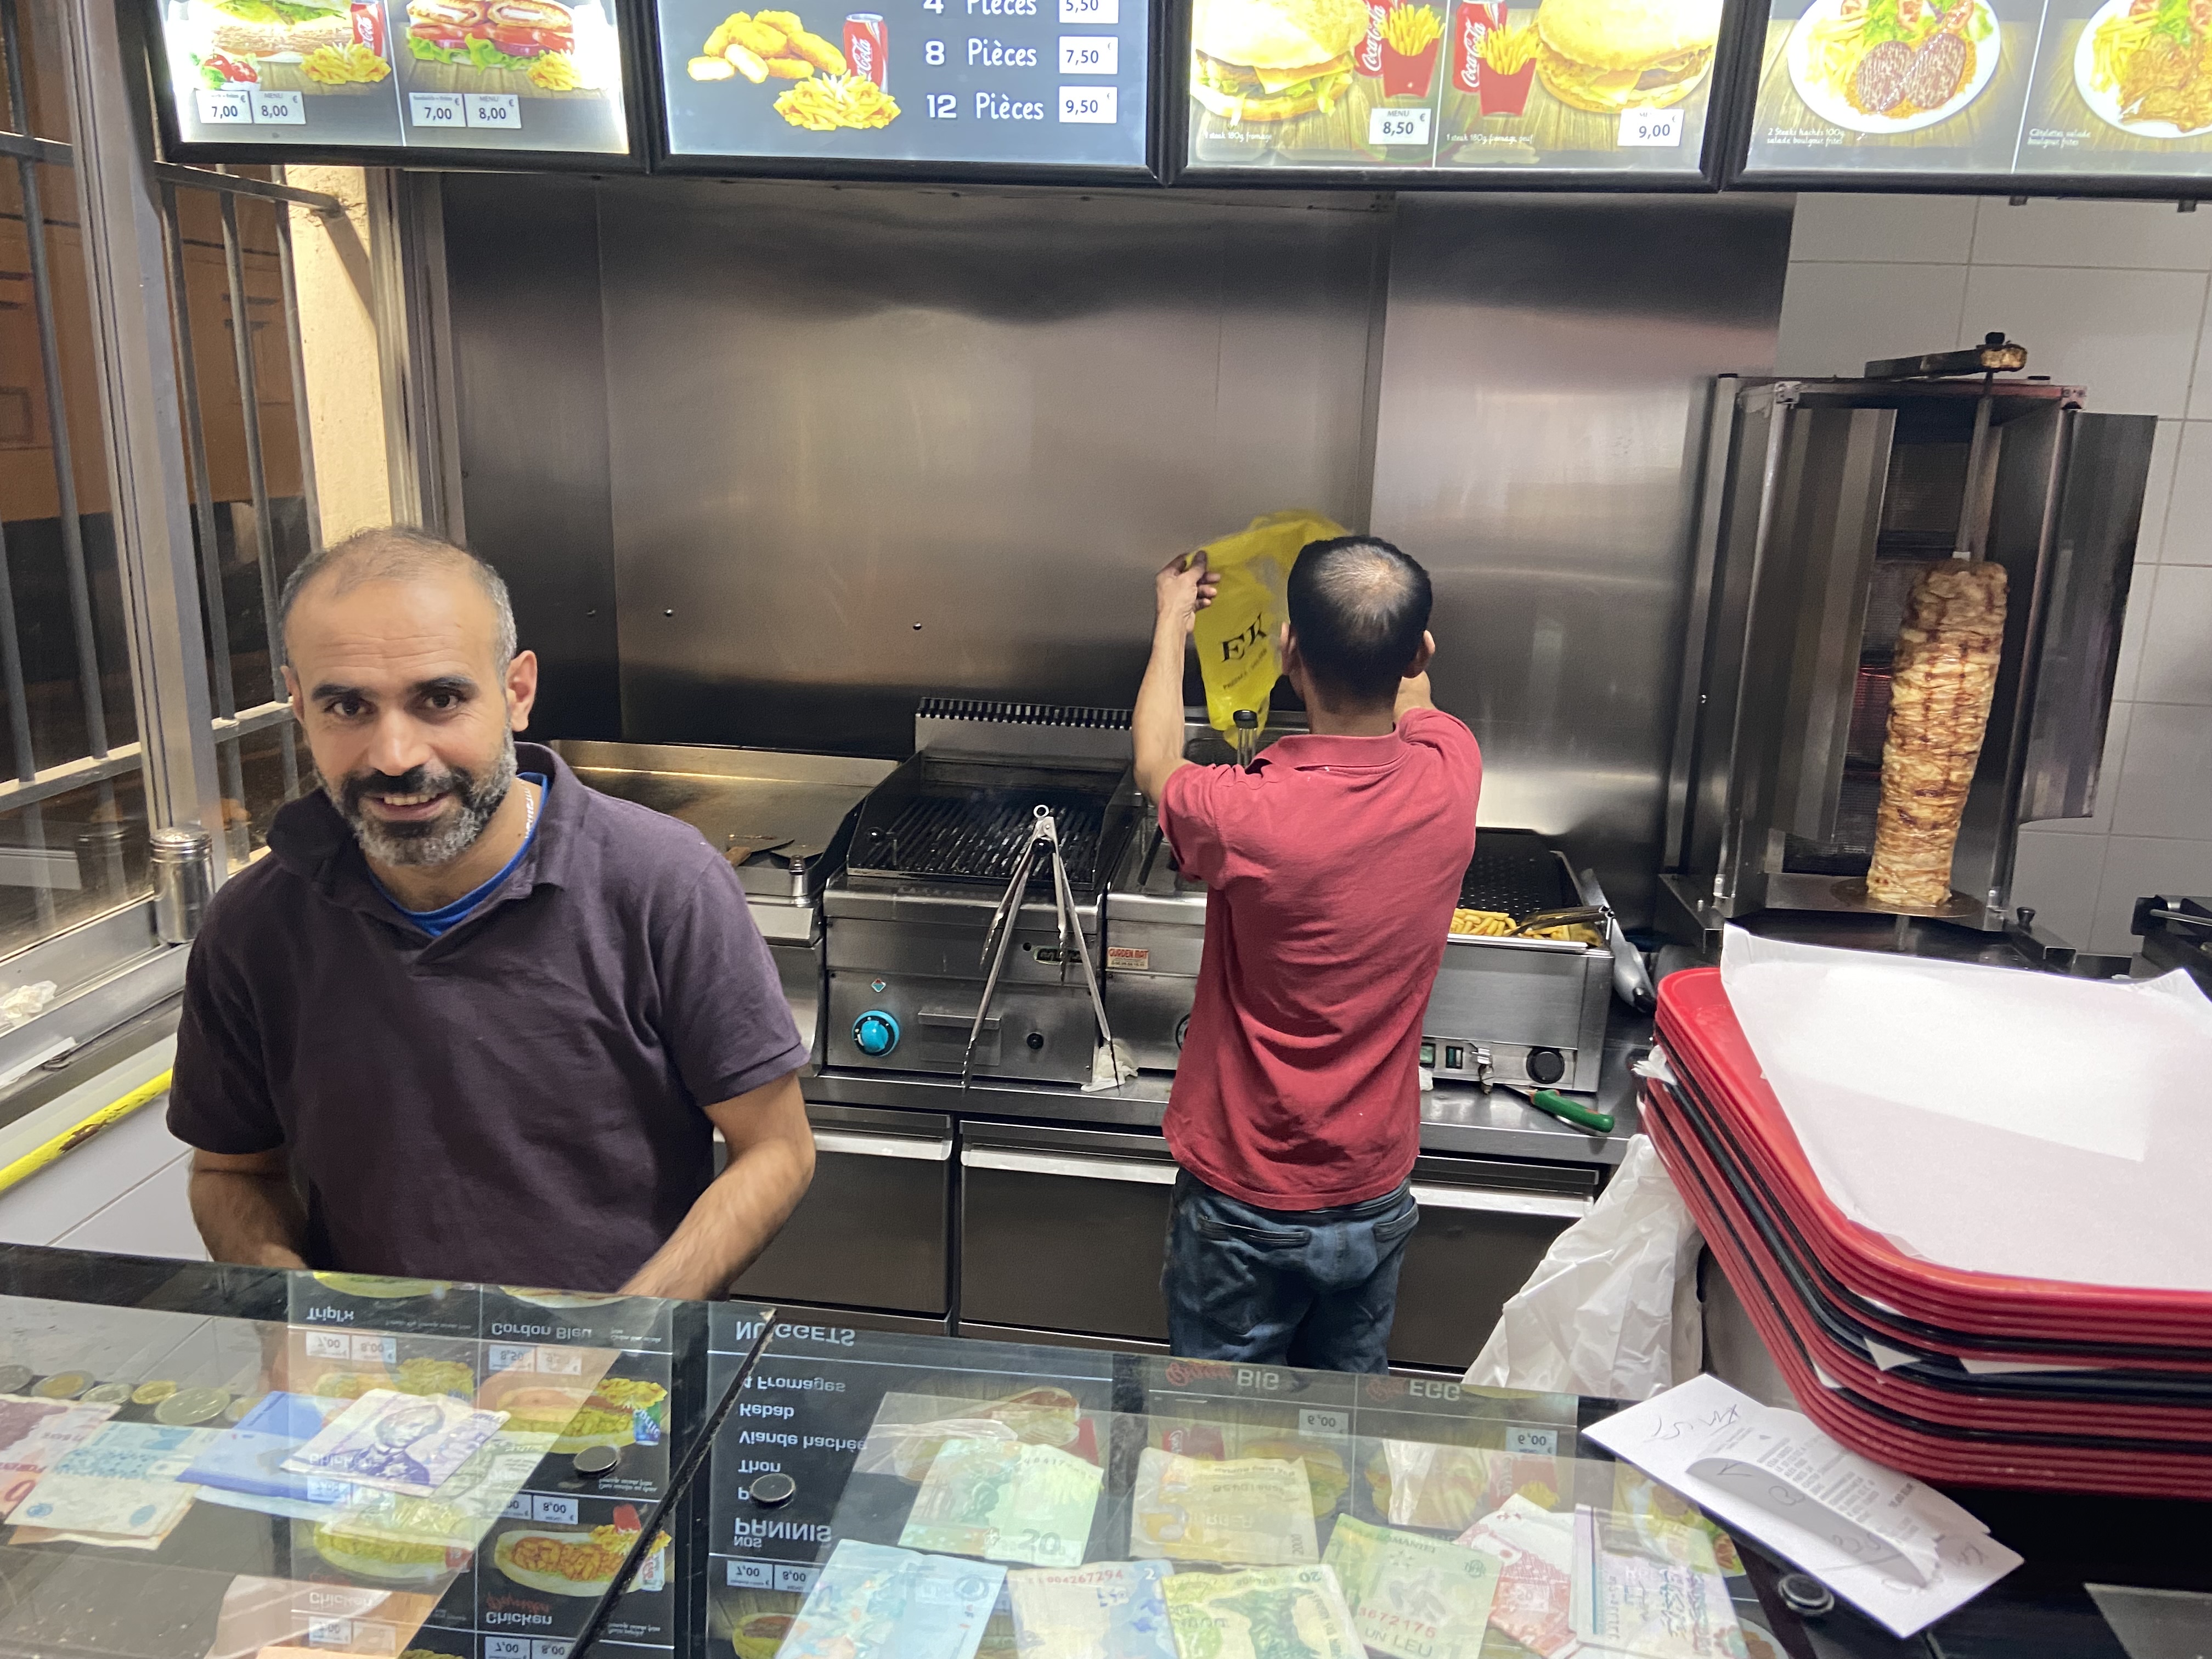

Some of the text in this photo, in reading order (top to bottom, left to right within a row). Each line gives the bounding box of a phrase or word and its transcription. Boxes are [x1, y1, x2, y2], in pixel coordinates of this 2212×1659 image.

[925, 38, 1037, 66] 8 Pièces
[1066, 49, 1099, 66] 7,50
[211, 106, 238, 119] 7,00
[261, 105, 288, 118] 8,00
[927, 92, 1044, 120] 12 Pièces
[1065, 100, 1098, 115] 9,50
[425, 107, 452, 121] 7,00
[479, 108, 506, 121] 8,00
[1383, 121, 1414, 136] 8,50
[1639, 124, 1671, 139] 9,00
[1018, 1528, 1062, 1555] 20
[1299, 1571, 1322, 1583] 20
[1365, 1627, 1432, 1658] UN LEU
